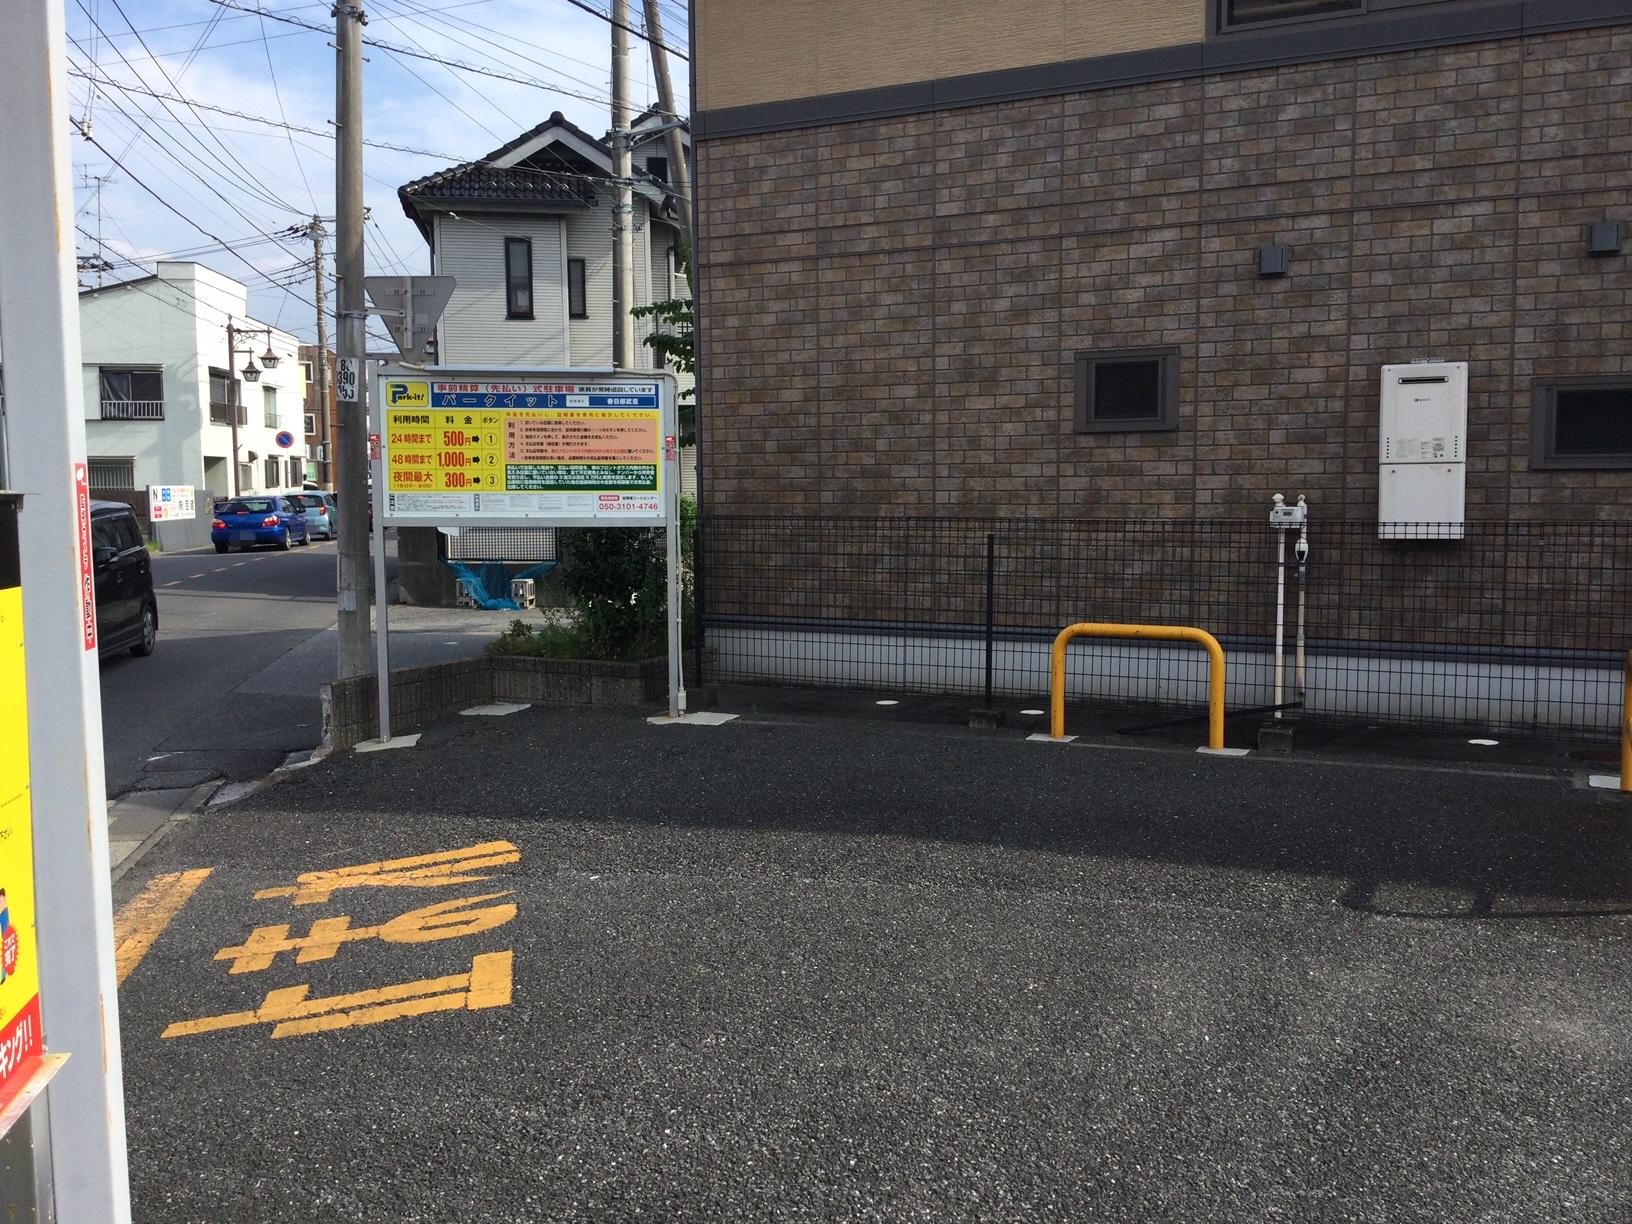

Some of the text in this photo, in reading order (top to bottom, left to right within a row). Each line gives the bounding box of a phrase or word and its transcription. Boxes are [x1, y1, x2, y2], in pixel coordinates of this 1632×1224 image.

[442, 394, 558, 407] パークイット
[393, 415, 499, 424] 利用時間 料金 ボタン
[391, 433, 432, 444] 24時間まで
[443, 431, 471, 447] 500円
[392, 454, 433, 465] 48時間まで
[437, 452, 472, 468] 1,000円
[393, 471, 433, 483] 夜間最大
[445, 472, 472, 488] 300円
